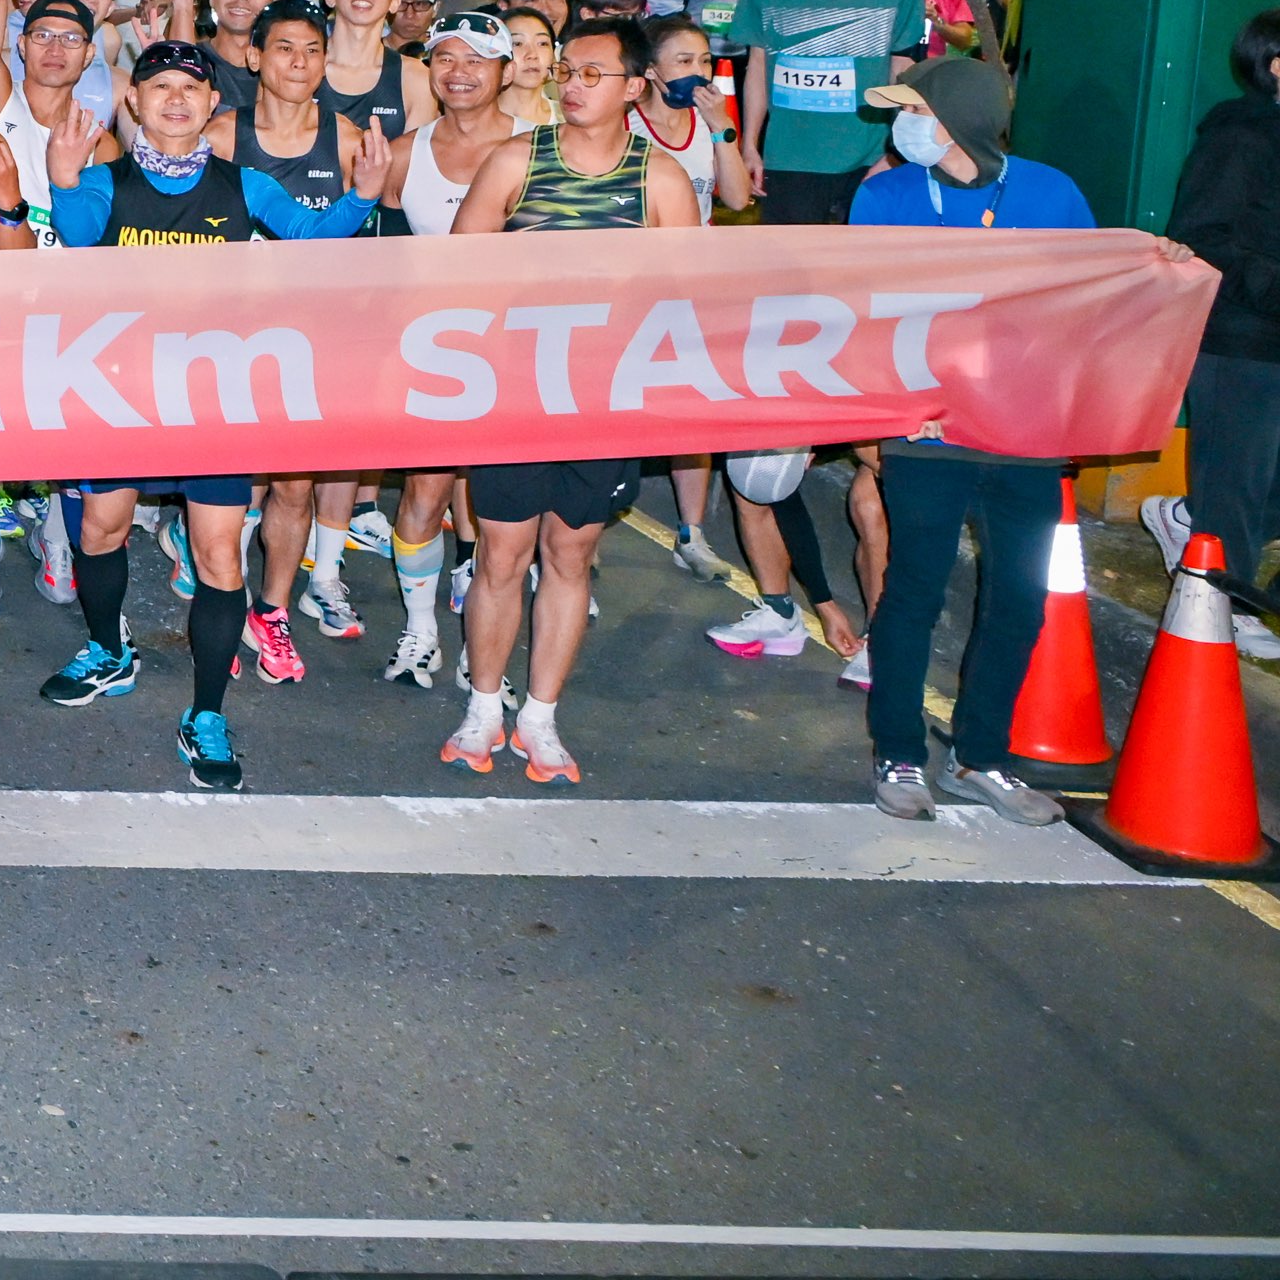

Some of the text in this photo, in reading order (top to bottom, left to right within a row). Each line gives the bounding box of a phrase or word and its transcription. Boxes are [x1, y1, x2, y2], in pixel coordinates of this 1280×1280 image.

[783, 71, 842, 87] 11574
[372, 106, 398, 115] titan
[308, 169, 334, 179] titan
[398, 292, 984, 422] START
